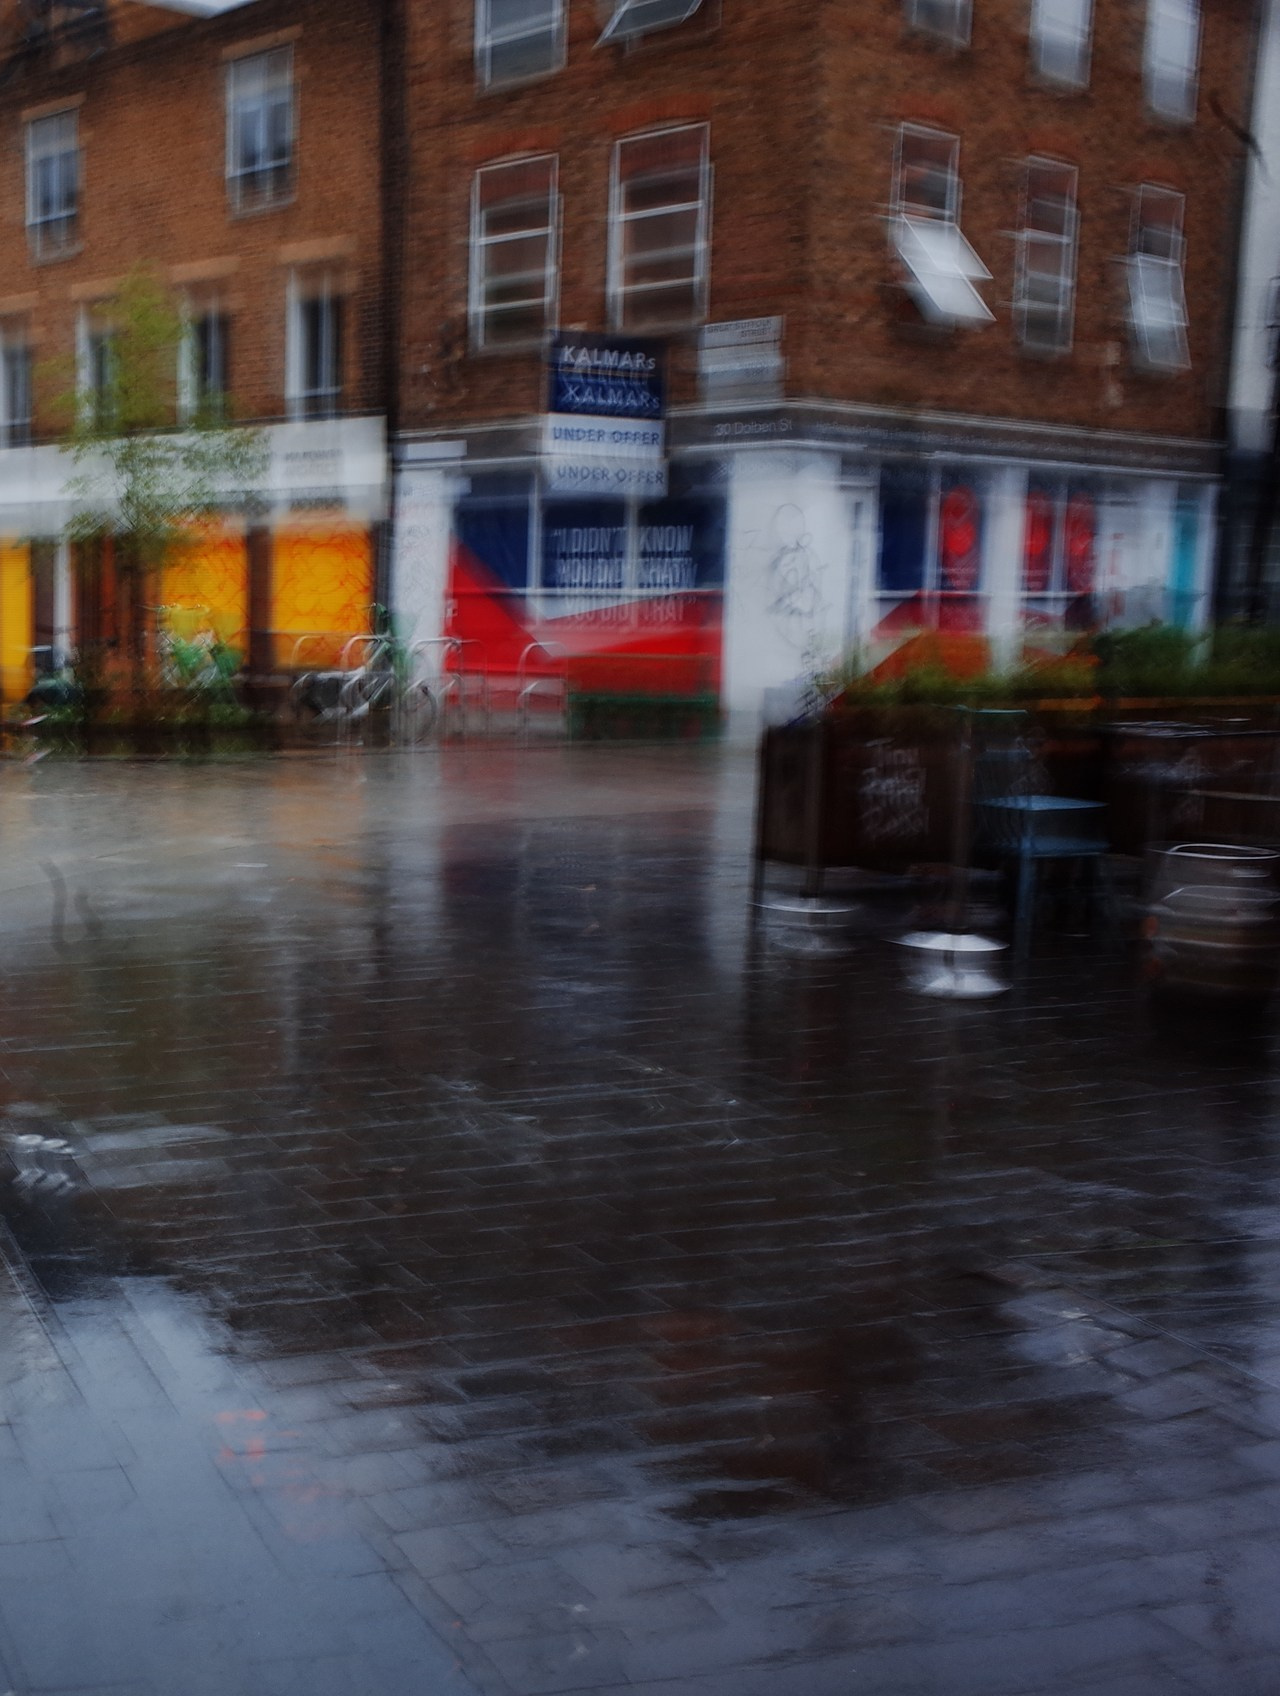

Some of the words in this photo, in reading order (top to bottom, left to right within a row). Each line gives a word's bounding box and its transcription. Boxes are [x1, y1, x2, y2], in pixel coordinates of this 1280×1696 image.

[553, 427, 606, 442] UNDER
[611, 430, 660, 445] OFFER
[557, 466, 610, 481] UNDER
[615, 468, 664, 484] OFFER
[638, 524, 694, 553] KNOW
